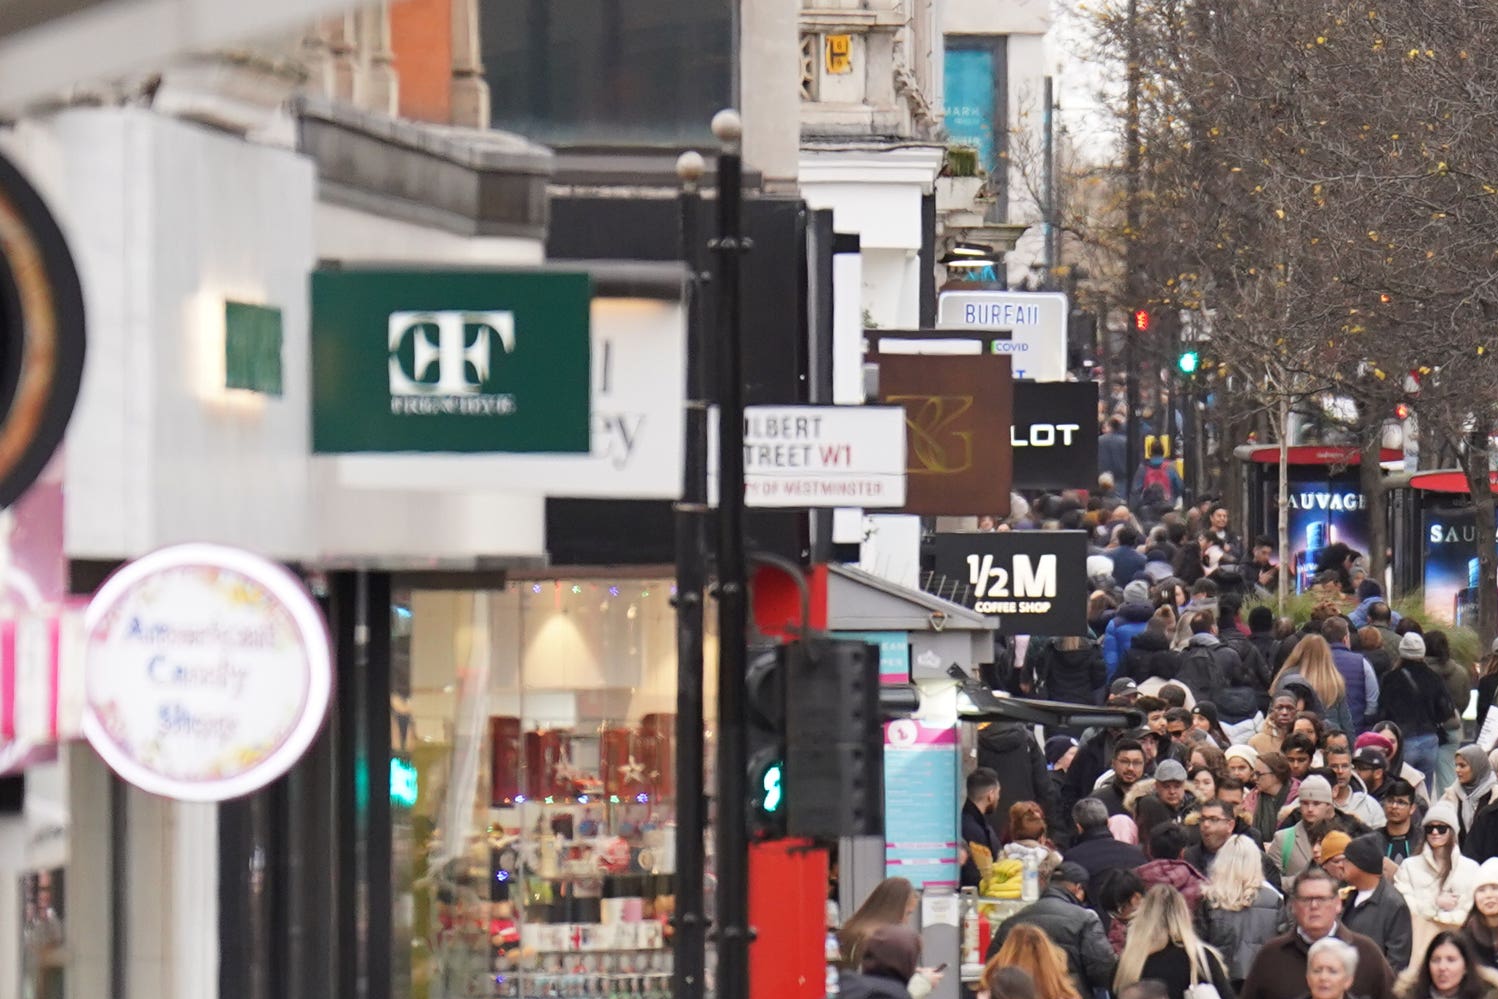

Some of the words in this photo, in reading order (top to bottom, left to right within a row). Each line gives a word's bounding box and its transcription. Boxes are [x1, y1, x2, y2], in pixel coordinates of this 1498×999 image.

[996, 343, 1029, 352] COVID
[744, 415, 823, 438] ILBERT
[1011, 424, 1080, 446] LOT
[743, 443, 813, 467] TREET
[818, 444, 852, 467] W1
[783, 480, 883, 496] WESTMINSTER
[1286, 493, 1366, 511] AUVAGE
[974, 601, 1017, 613] COFFEE
[1018, 601, 1051, 613] SHOP
